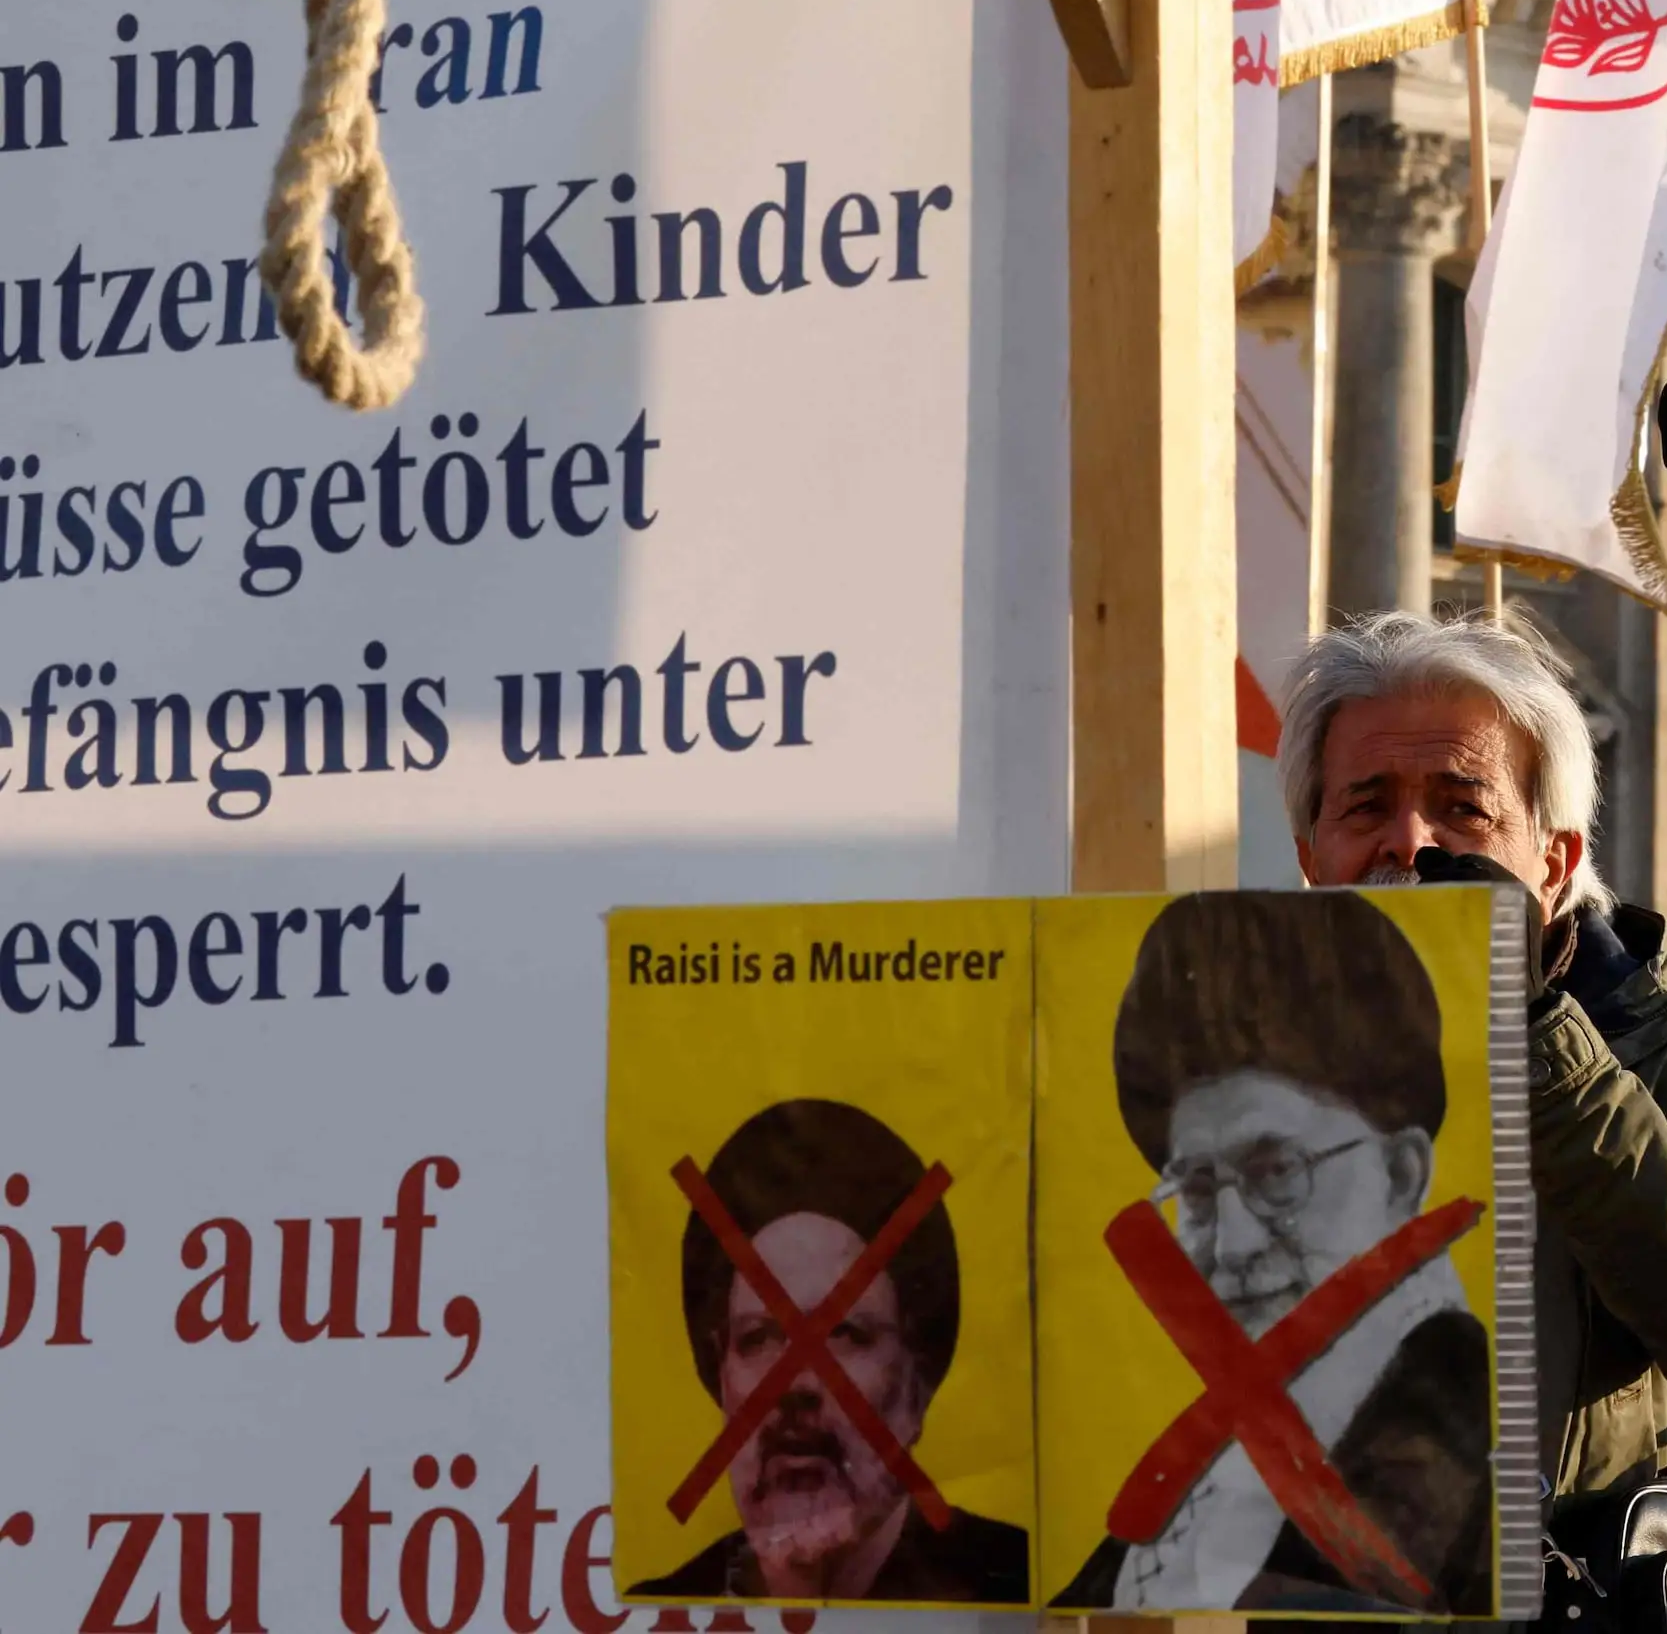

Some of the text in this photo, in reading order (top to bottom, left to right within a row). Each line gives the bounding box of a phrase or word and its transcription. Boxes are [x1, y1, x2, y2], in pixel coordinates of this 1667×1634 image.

[109, 12, 259, 142] im
[368, 5, 545, 116] ran
[0, 160, 954, 367] utzen Kinder
[238, 407, 662, 598] getötet
[0, 630, 837, 821] fängnis unter
[0, 872, 451, 1048] esperrt.
[628, 937, 1005, 986] Raisi is a Murderer
[174, 1154, 482, 1383] auf,
[77, 1511, 269, 1634] zu
